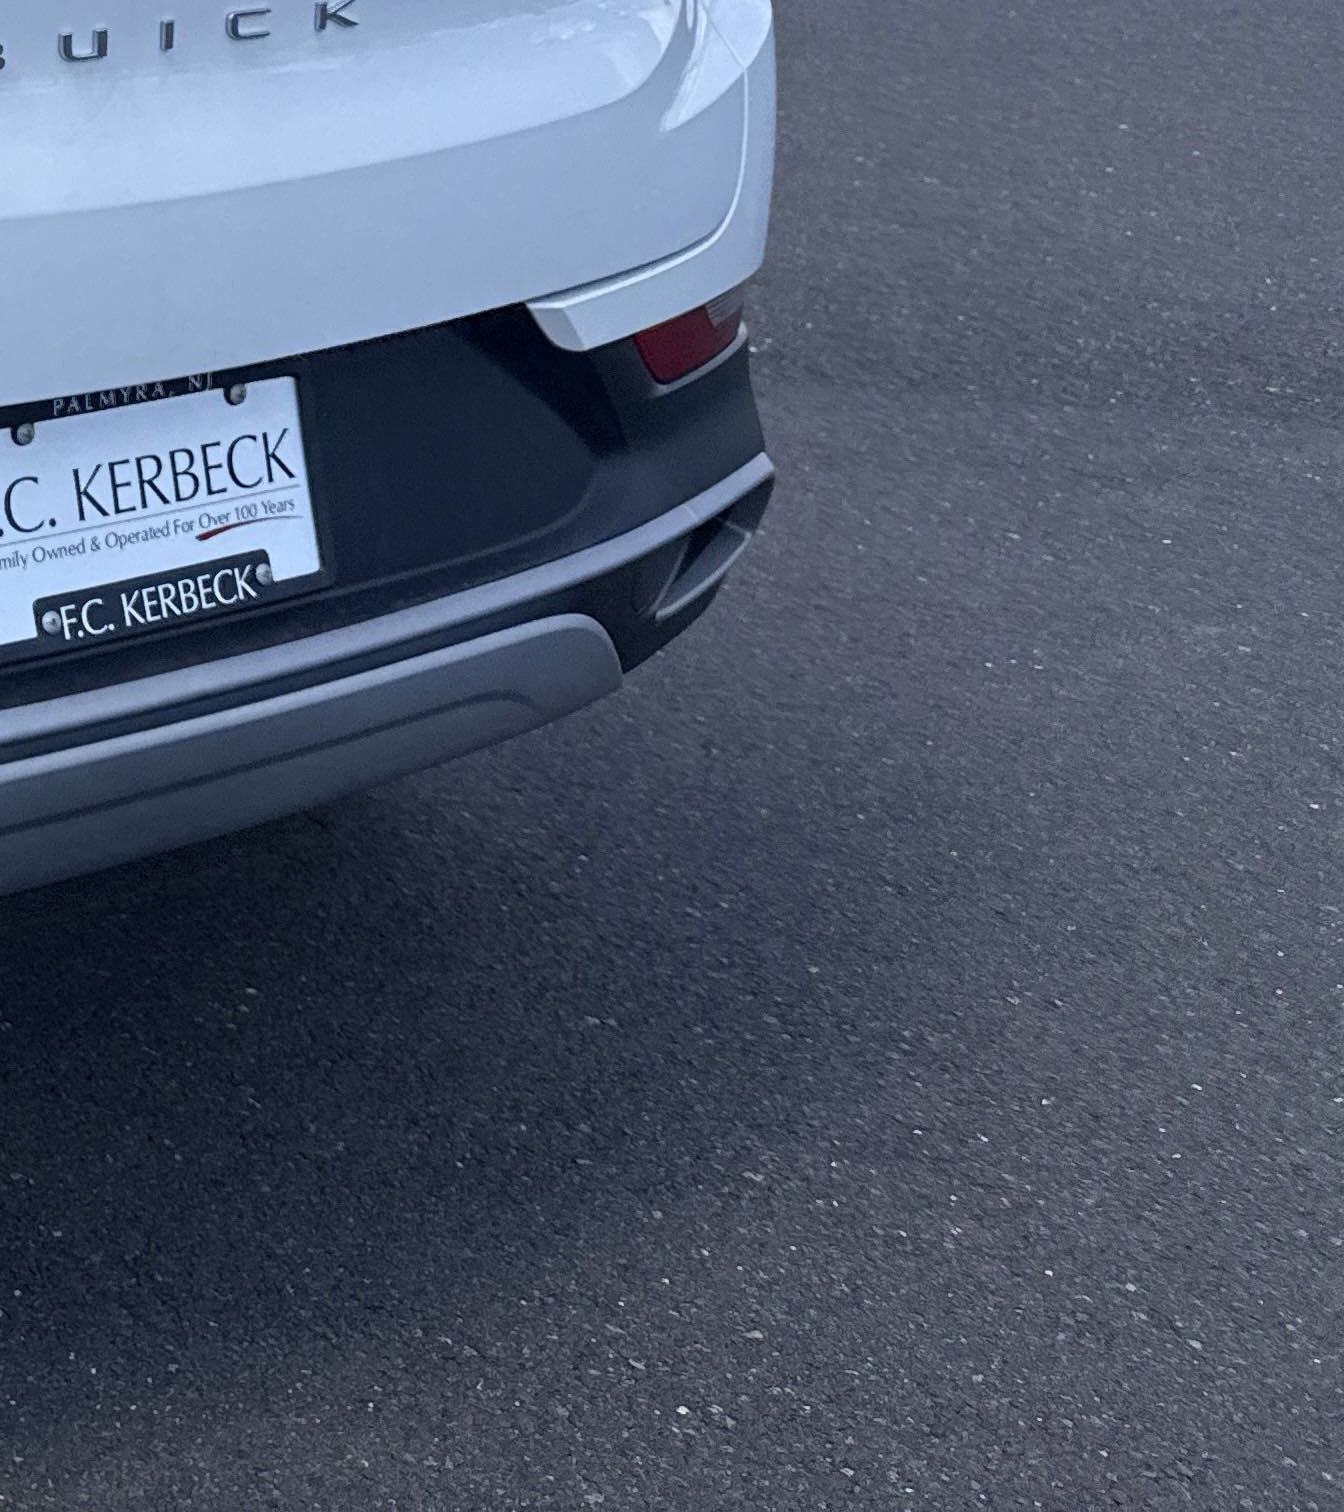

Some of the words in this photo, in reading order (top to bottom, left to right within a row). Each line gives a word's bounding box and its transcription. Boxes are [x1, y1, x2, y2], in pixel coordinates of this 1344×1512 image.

[72, 427, 297, 521] KERBECK
[31, 536, 86, 563] Owned
[90, 536, 102, 552] &
[105, 520, 170, 550] Operated
[173, 517, 196, 537] For
[198, 511, 231, 529] Over
[235, 503, 258, 521] 100
[262, 498, 296, 515] Years
[60, 597, 115, 640] F.C.
[120, 564, 258, 627] KERBECK
